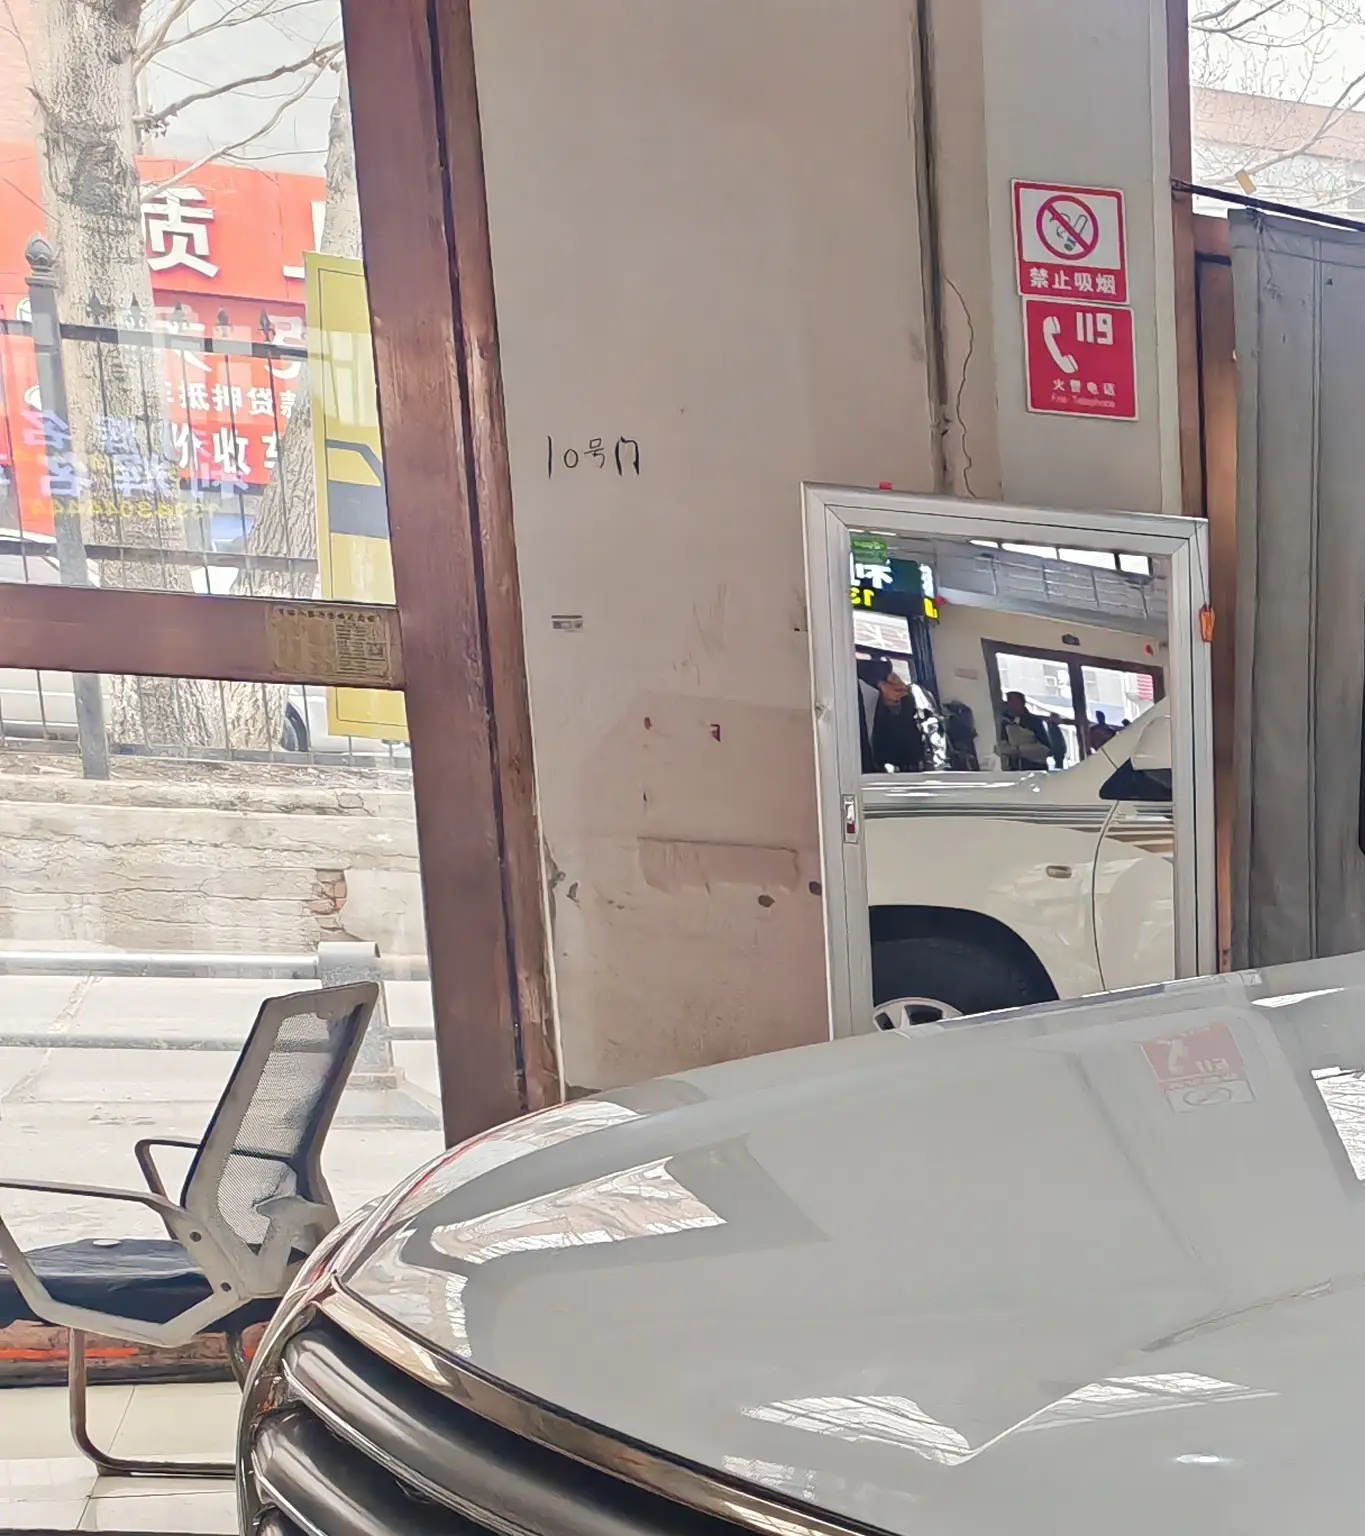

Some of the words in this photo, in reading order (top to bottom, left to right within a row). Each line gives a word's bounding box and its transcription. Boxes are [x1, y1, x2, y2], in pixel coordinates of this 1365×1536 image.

[1028, 266, 1117, 296] 禁止吸烟
[1075, 311, 1114, 346] 119
